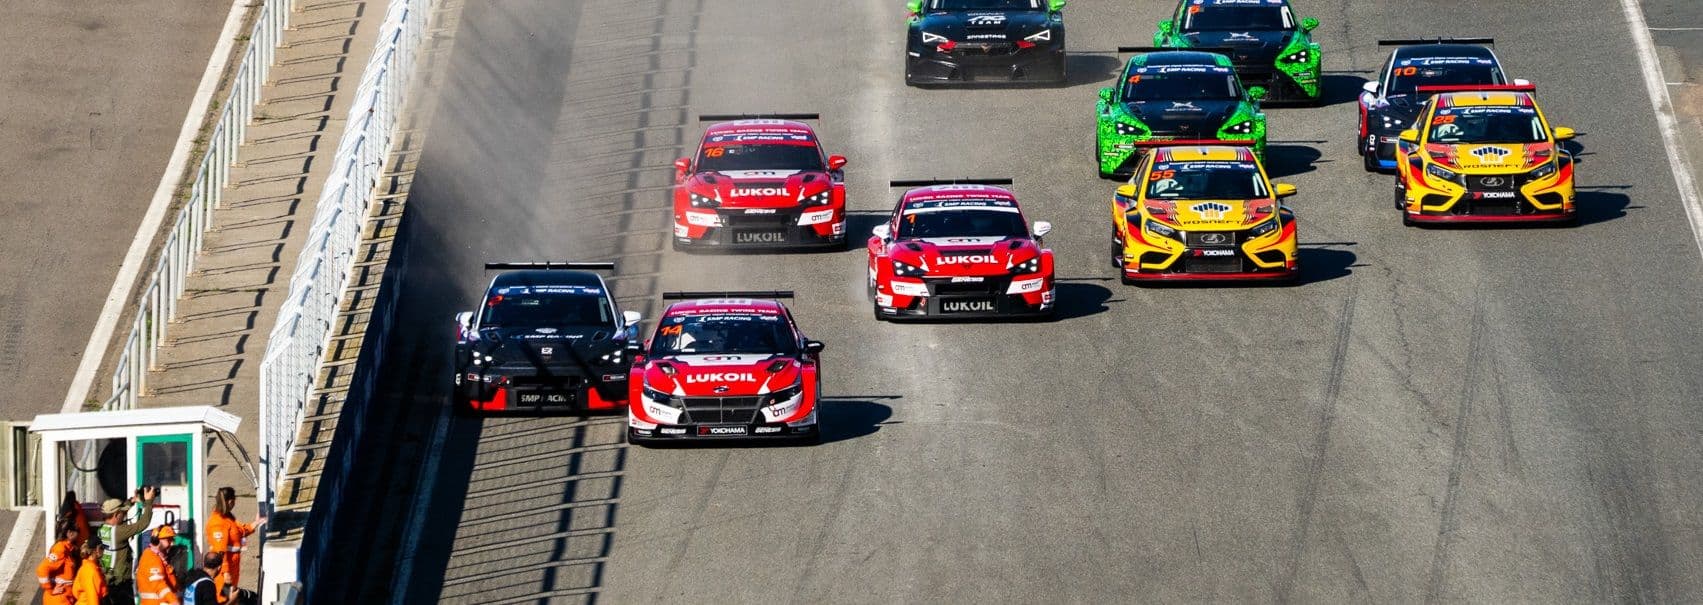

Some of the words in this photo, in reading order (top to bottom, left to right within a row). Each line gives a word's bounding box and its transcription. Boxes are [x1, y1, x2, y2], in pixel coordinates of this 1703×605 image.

[1394, 66, 1417, 76] 10
[1128, 75, 1141, 84] 4
[704, 147, 725, 158] 16
[1150, 169, 1176, 180] 55
[730, 188, 790, 197] LUKOIL
[736, 232, 785, 242] LUKOIL
[936, 255, 999, 265] LUKOIL
[944, 301, 993, 311] LUKOIL
[661, 324, 682, 336] 14
[686, 372, 757, 384] LUKOIL
[521, 394, 541, 403] SMP
[710, 426, 746, 434] YOKOHAMA
